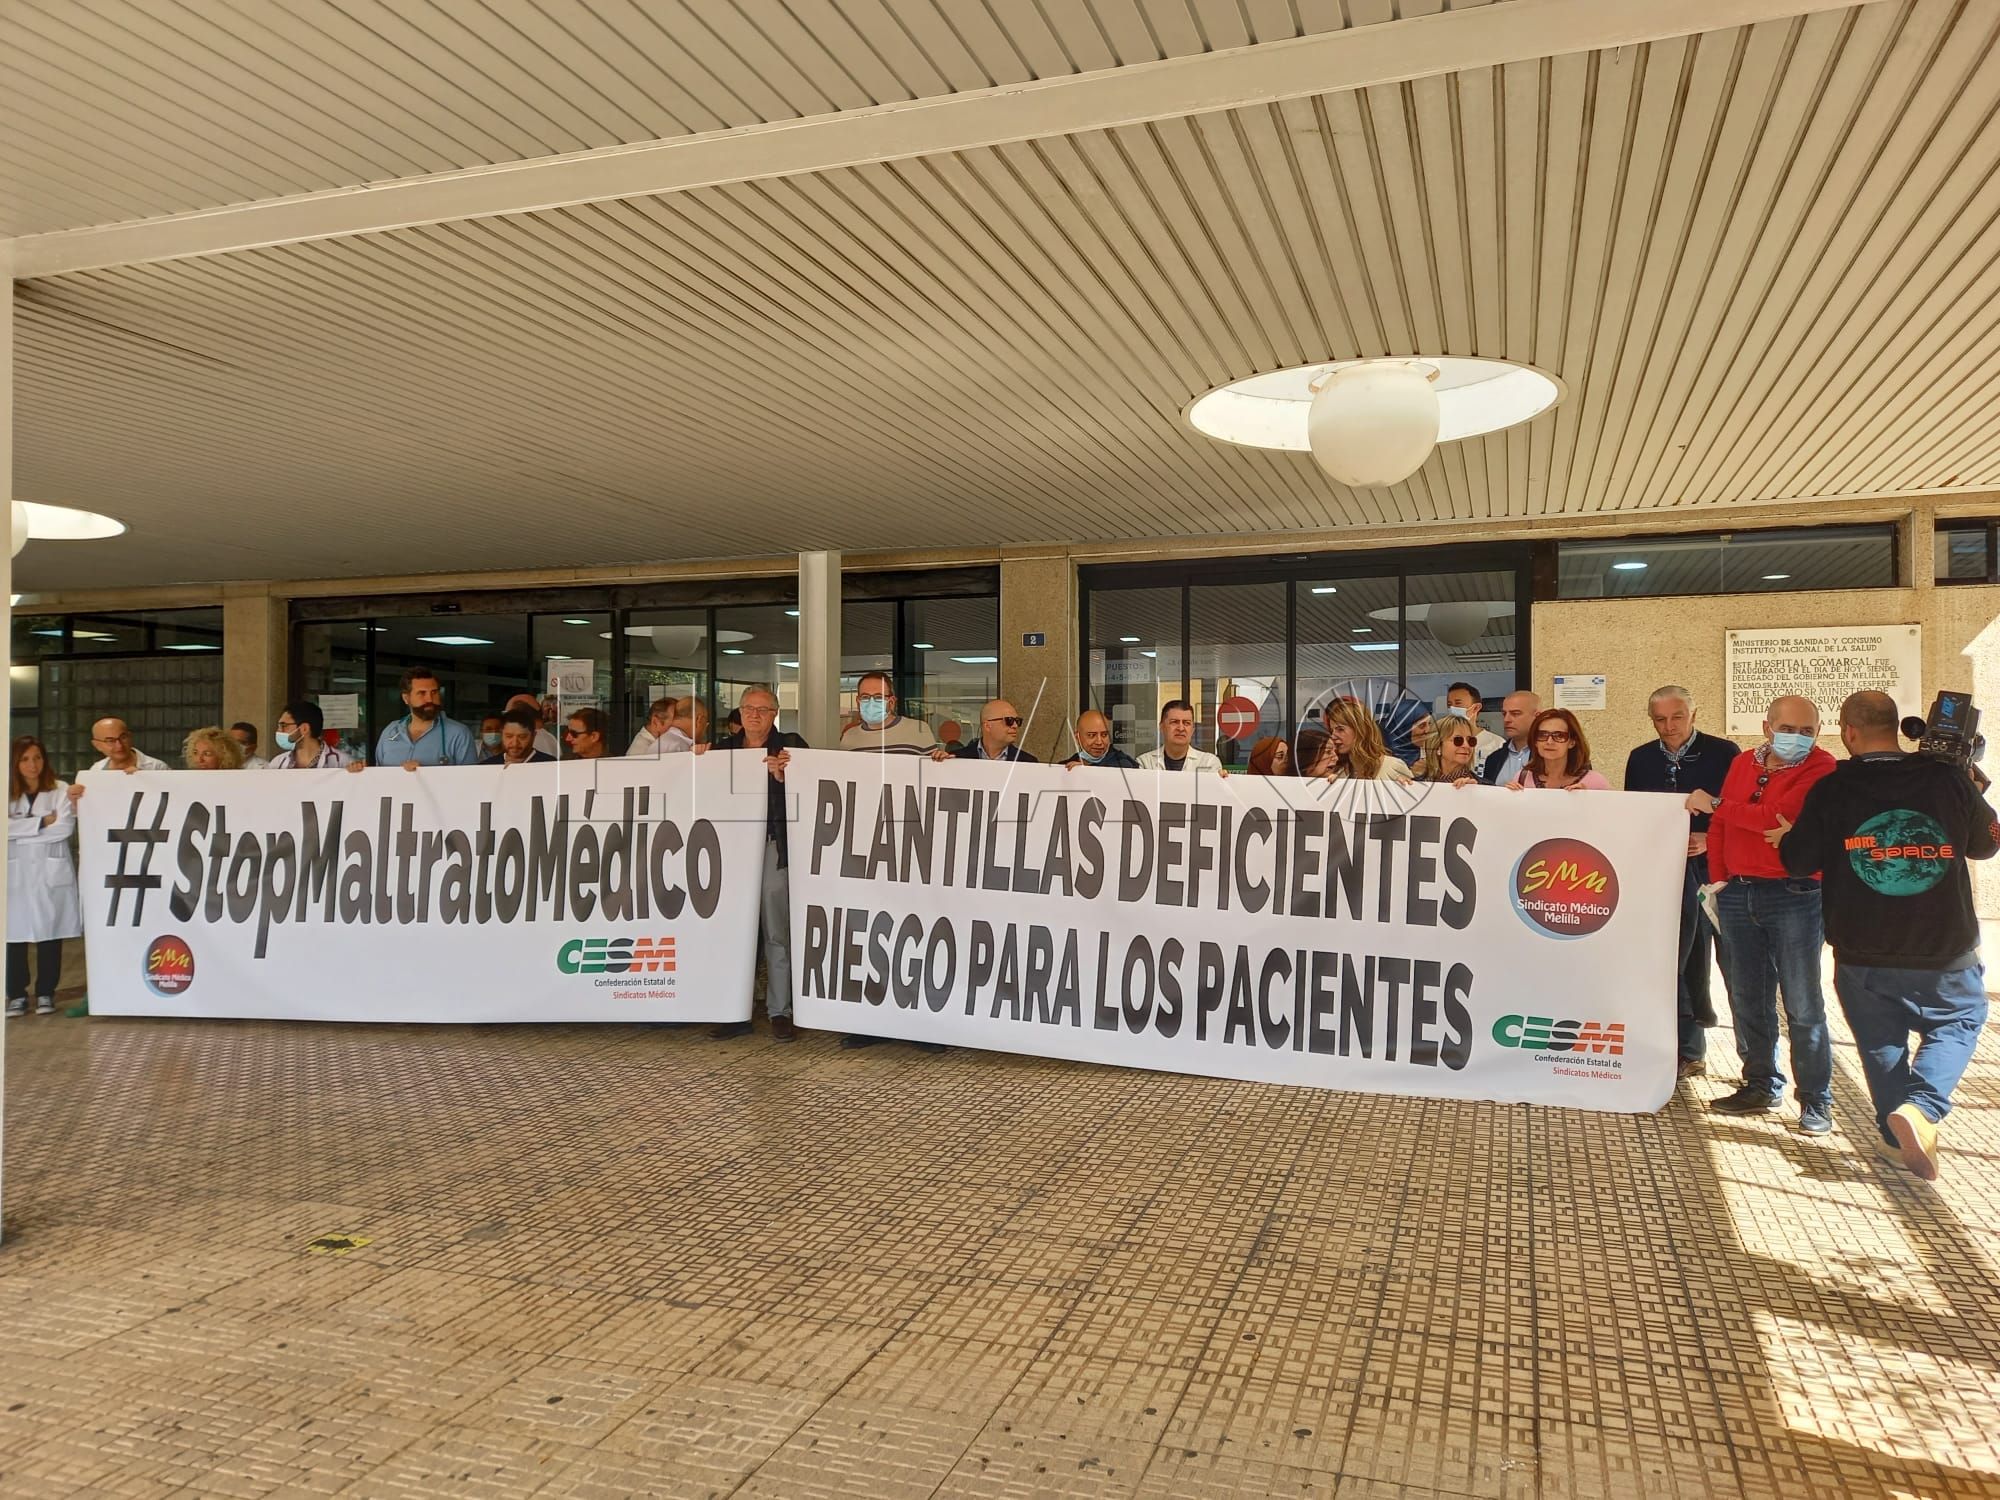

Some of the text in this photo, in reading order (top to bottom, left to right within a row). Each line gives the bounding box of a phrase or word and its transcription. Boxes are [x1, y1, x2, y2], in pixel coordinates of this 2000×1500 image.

[1030, 635, 1037, 645] 2
[1732, 639, 1779, 647] MINISTERIO
[1793, 638, 1829, 646] SANIDAD
[1841, 636, 1882, 644] CONSUMO
[1850, 644, 1877, 652] SALUD
[1754, 659, 1806, 668] HOSPITAL
[1809, 657, 1872, 666] COMARCAL
[1732, 667, 1786, 675] INAUGURADO
[1831, 665, 1841, 673] DE
[1867, 664, 1897, 672] SIENDO
[1732, 674, 1774, 682] DELEGADO
[1776, 673, 1791, 681] DEL
[1793, 673, 1835, 681] GOBIERNO
[1851, 671, 1887, 679] MELILLA
[1890, 671, 1901, 679] EL
[1732, 690, 1749, 698] POR
[1732, 696, 1777, 706] SANIDA
[1844, 836, 1877, 850] MORE
[810, 779, 1478, 930] PLANTILLAS DEFICIENTES
[1870, 845, 1955, 861] SPACE
[104, 786, 722, 958] #StopMaltratoMédico
[1517, 898, 1610, 916] Sindicato Médico
[1544, 912, 1580, 925] Melilla
[557, 937, 676, 974] CESM
[594, 977, 676, 987] Confederación Estatal de
[802, 904, 1474, 1071] RIESGO PARA LOS PACIENTES
[613, 990, 676, 999] Sindicatos Médicos
[1492, 1014, 1625, 1055] CESM
[1534, 1054, 1622, 1068] Confederación Estatal de
[1553, 1066, 1622, 1080] Sindicatos Médicos
